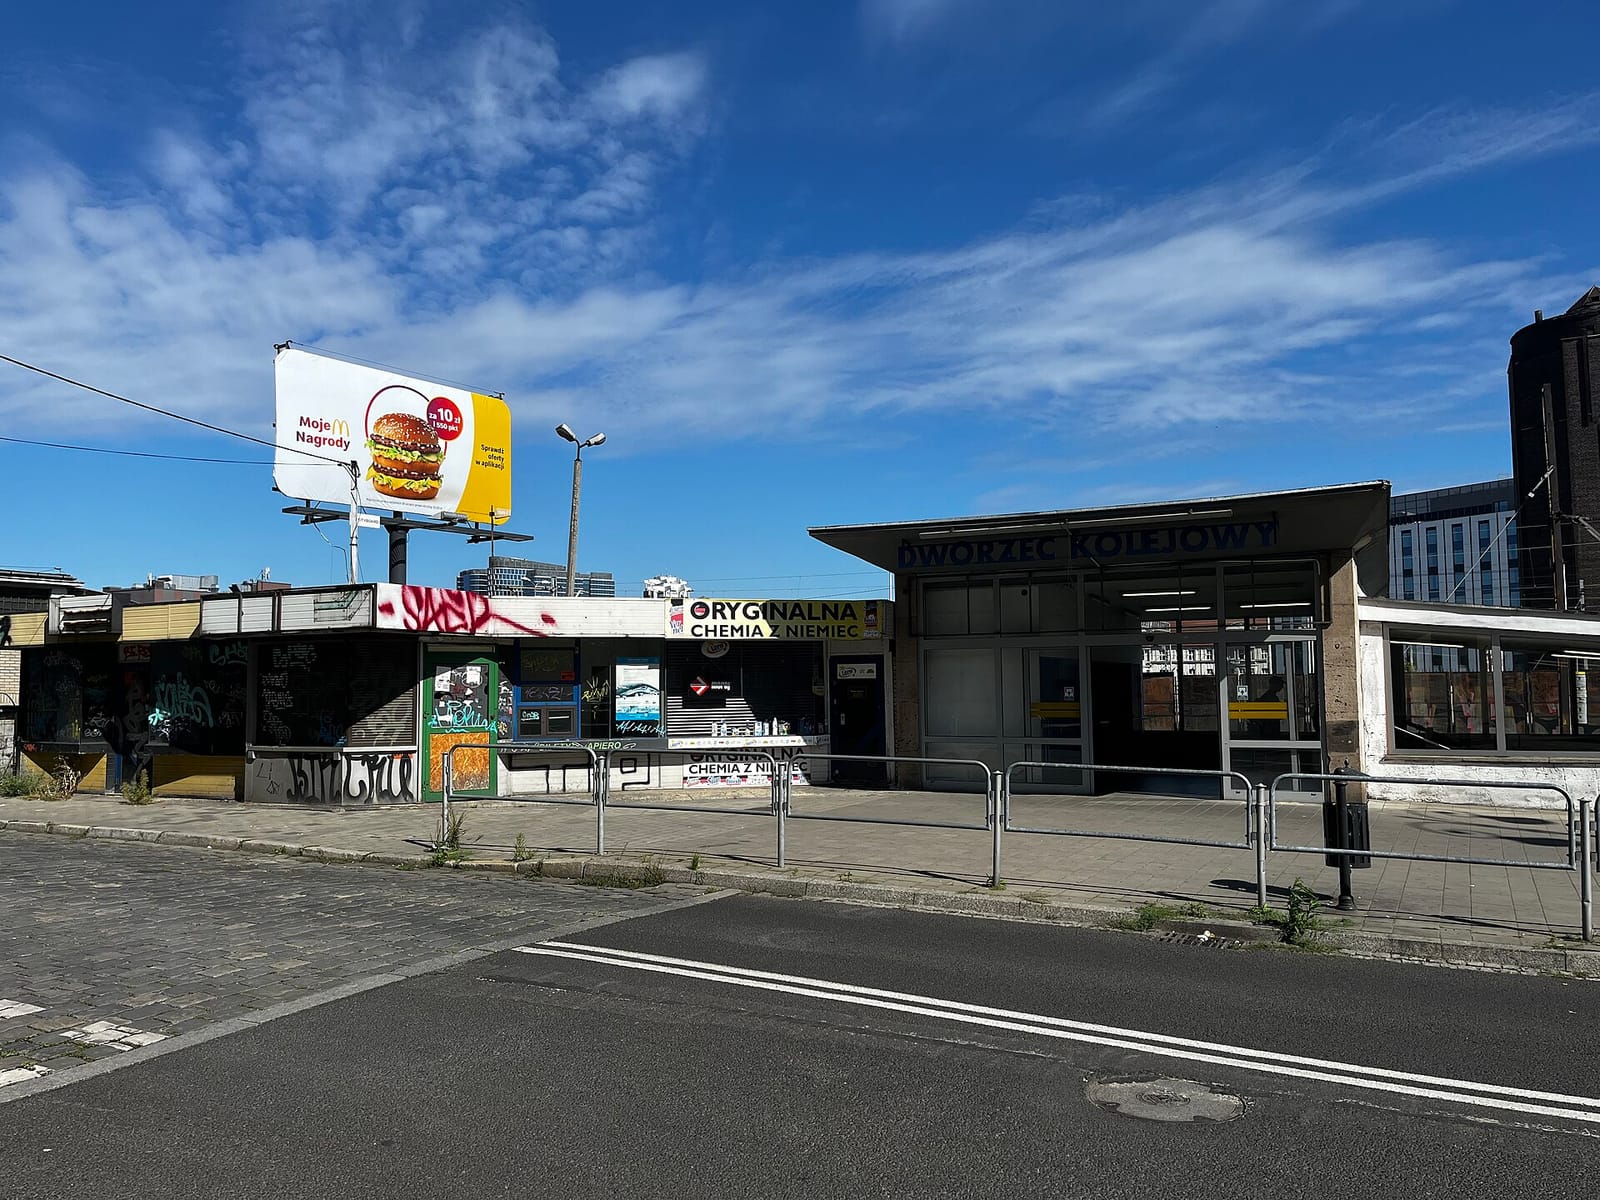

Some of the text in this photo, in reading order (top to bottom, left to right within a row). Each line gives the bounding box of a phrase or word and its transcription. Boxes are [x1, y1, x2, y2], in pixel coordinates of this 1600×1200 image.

[437, 408, 453, 422] 10
[299, 416, 331, 432] Moje
[436, 422, 448, 430] 550
[296, 431, 350, 451] Nagrody
[488, 454, 504, 464] oferty
[898, 521, 1275, 569] DWORZEC KOLEJOWY
[690, 601, 857, 621] ORYGINALNA
[690, 624, 763, 638] CHEMIA
[769, 624, 781, 638] Z
[786, 624, 859, 638] NIEMIEC
[689, 762, 808, 774] CHEMIA Z NIEC
